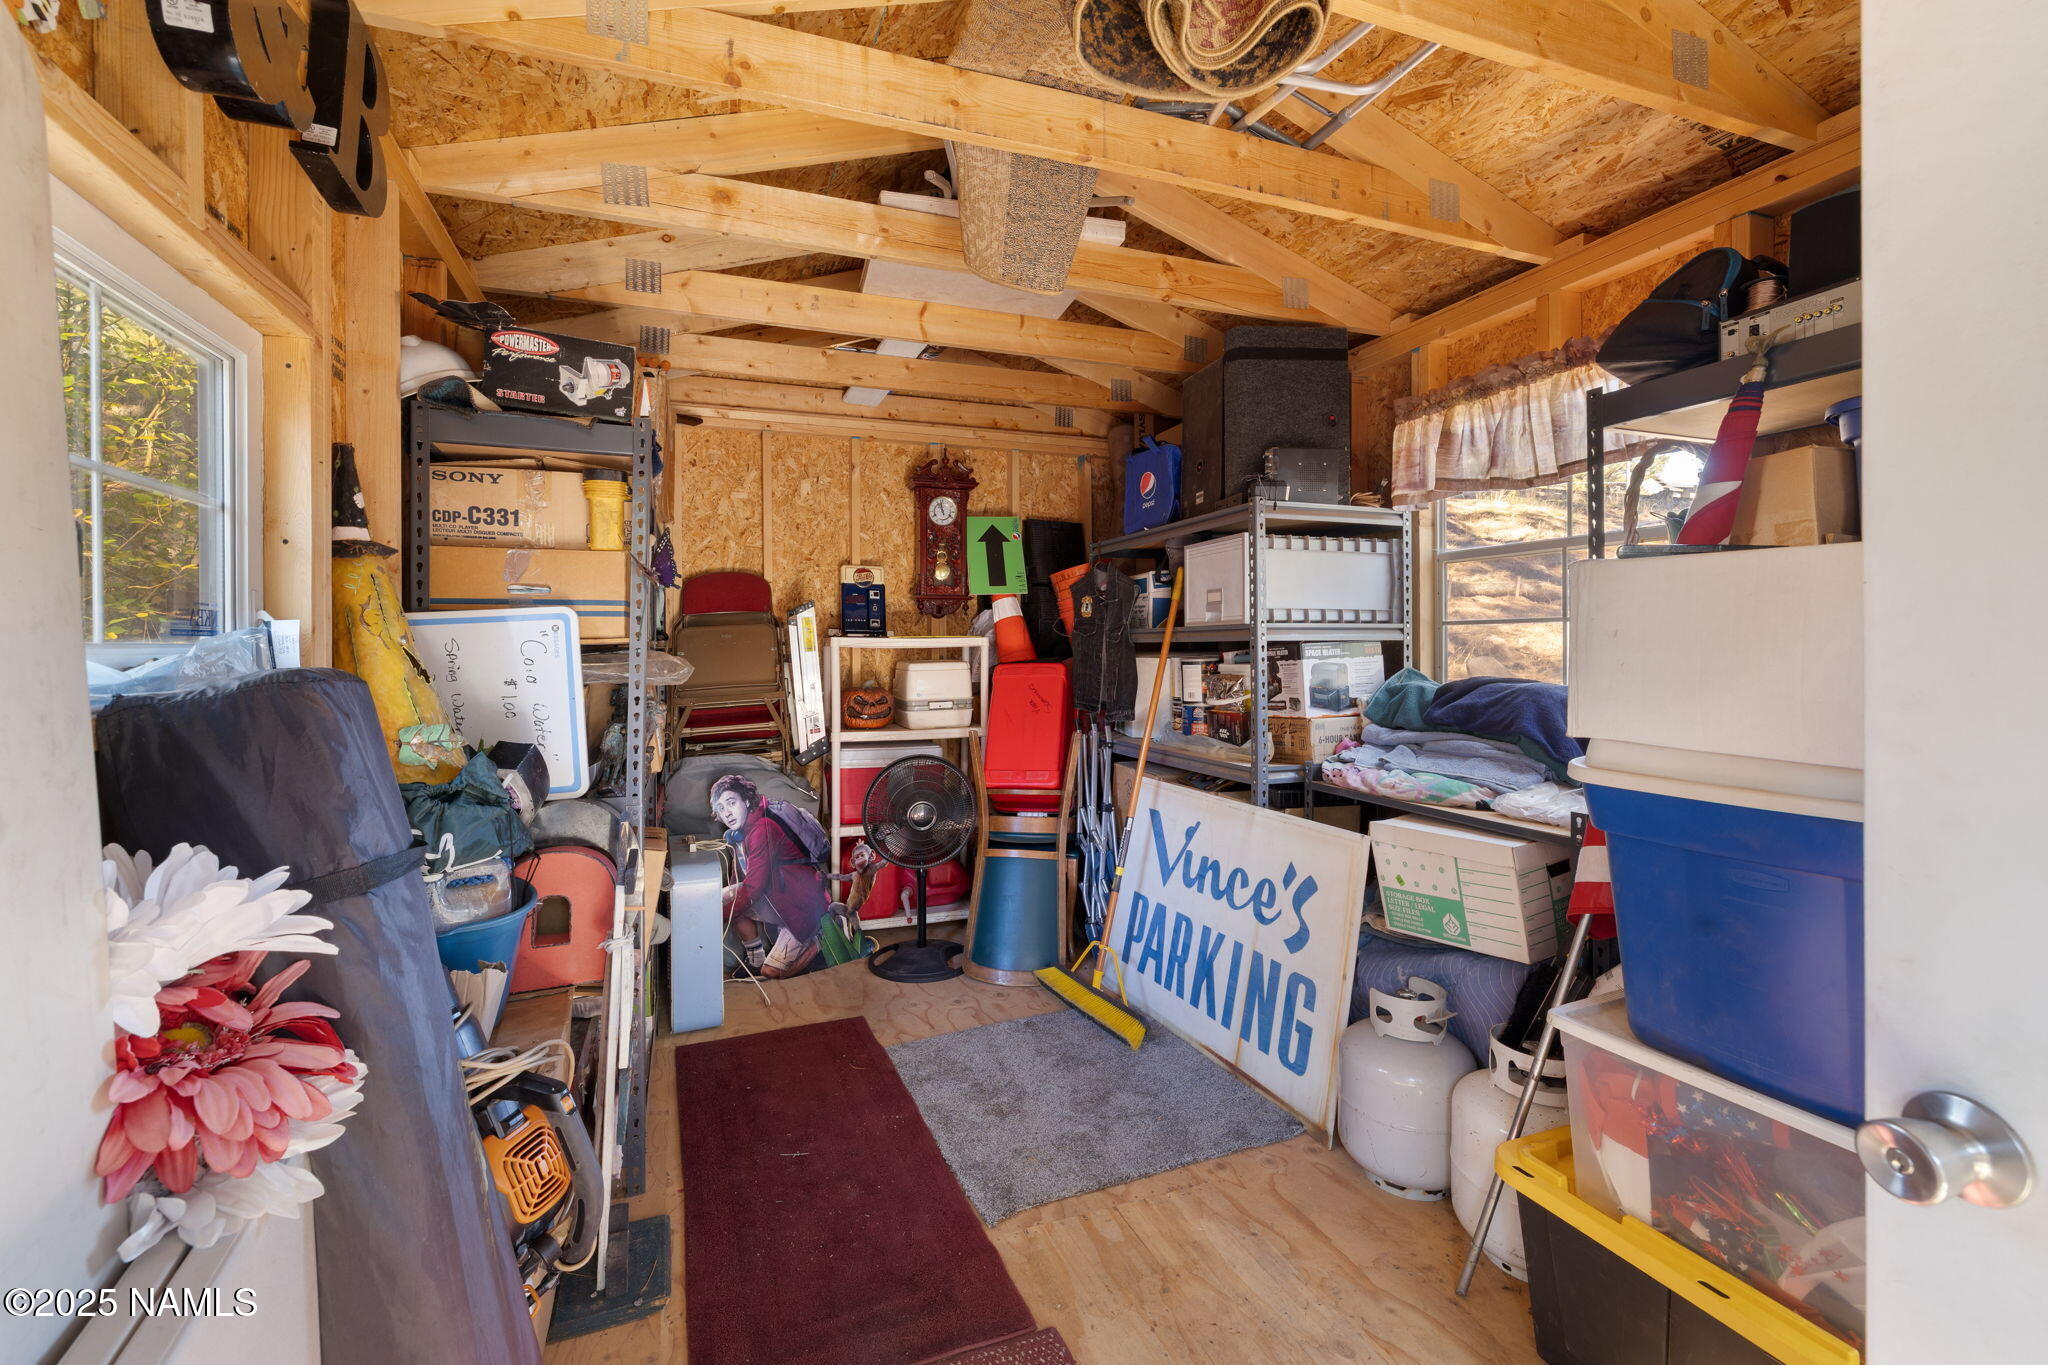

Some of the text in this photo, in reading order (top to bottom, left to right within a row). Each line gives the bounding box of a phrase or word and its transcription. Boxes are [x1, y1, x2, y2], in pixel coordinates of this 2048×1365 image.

[499, 333, 553, 352] POWERMASTER
[491, 347, 557, 363] Performance
[496, 388, 545, 404] STARTER
[431, 470, 503, 484] SONY
[432, 506, 520, 527] CDP-C331
[445, 638, 465, 737] Spring Water
[1149, 808, 1319, 954] Vince's
[1386, 890, 1431, 905] STORAGE BOX
[1387, 896, 1410, 907] LETTER
[1415, 902, 1436, 913] LEGAL
[1388, 903, 1421, 916] SIZE FILES
[1122, 891, 1317, 1077] PARKING
